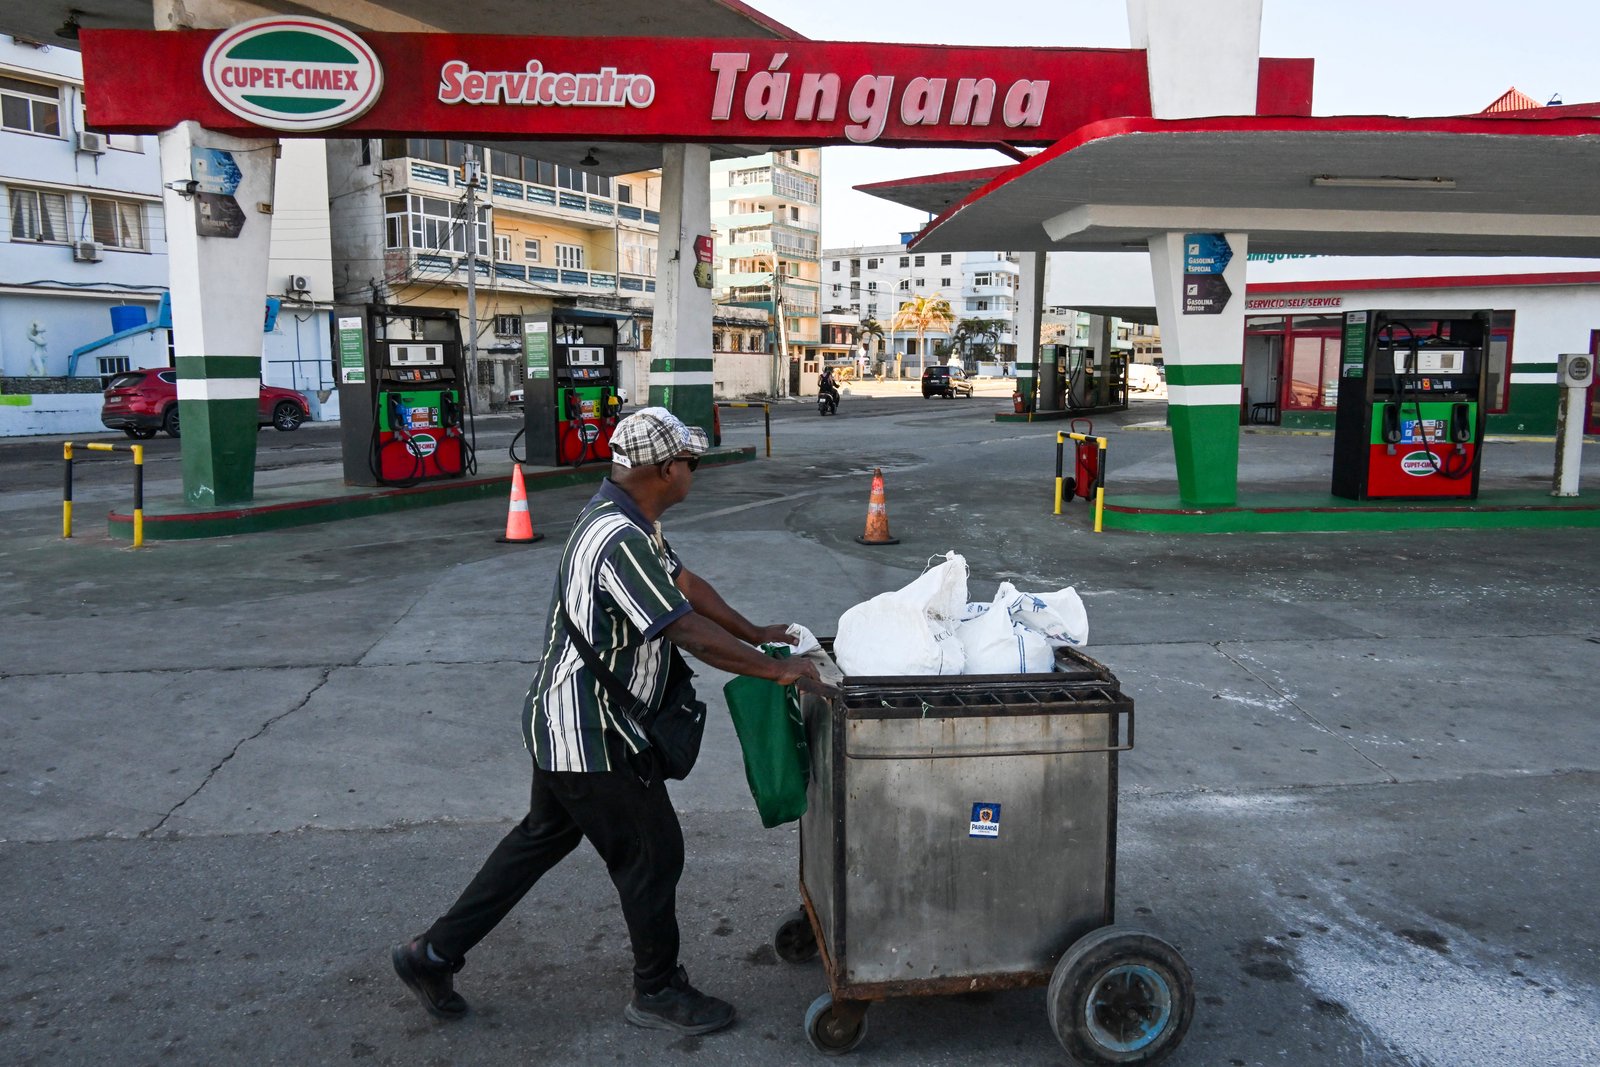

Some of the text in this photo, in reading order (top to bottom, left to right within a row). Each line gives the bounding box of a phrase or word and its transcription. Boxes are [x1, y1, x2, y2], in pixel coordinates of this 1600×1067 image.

[221, 66, 359, 91] CUPET-CIMEX
[438, 52, 1051, 144] Servicentro Tángana
[1248, 297, 1342, 309] SERVICIO SELF SERVICE
[1405, 421, 1414, 429] 15
[1435, 421, 1444, 429] 13
[971, 824, 998, 832] PARRANDA
